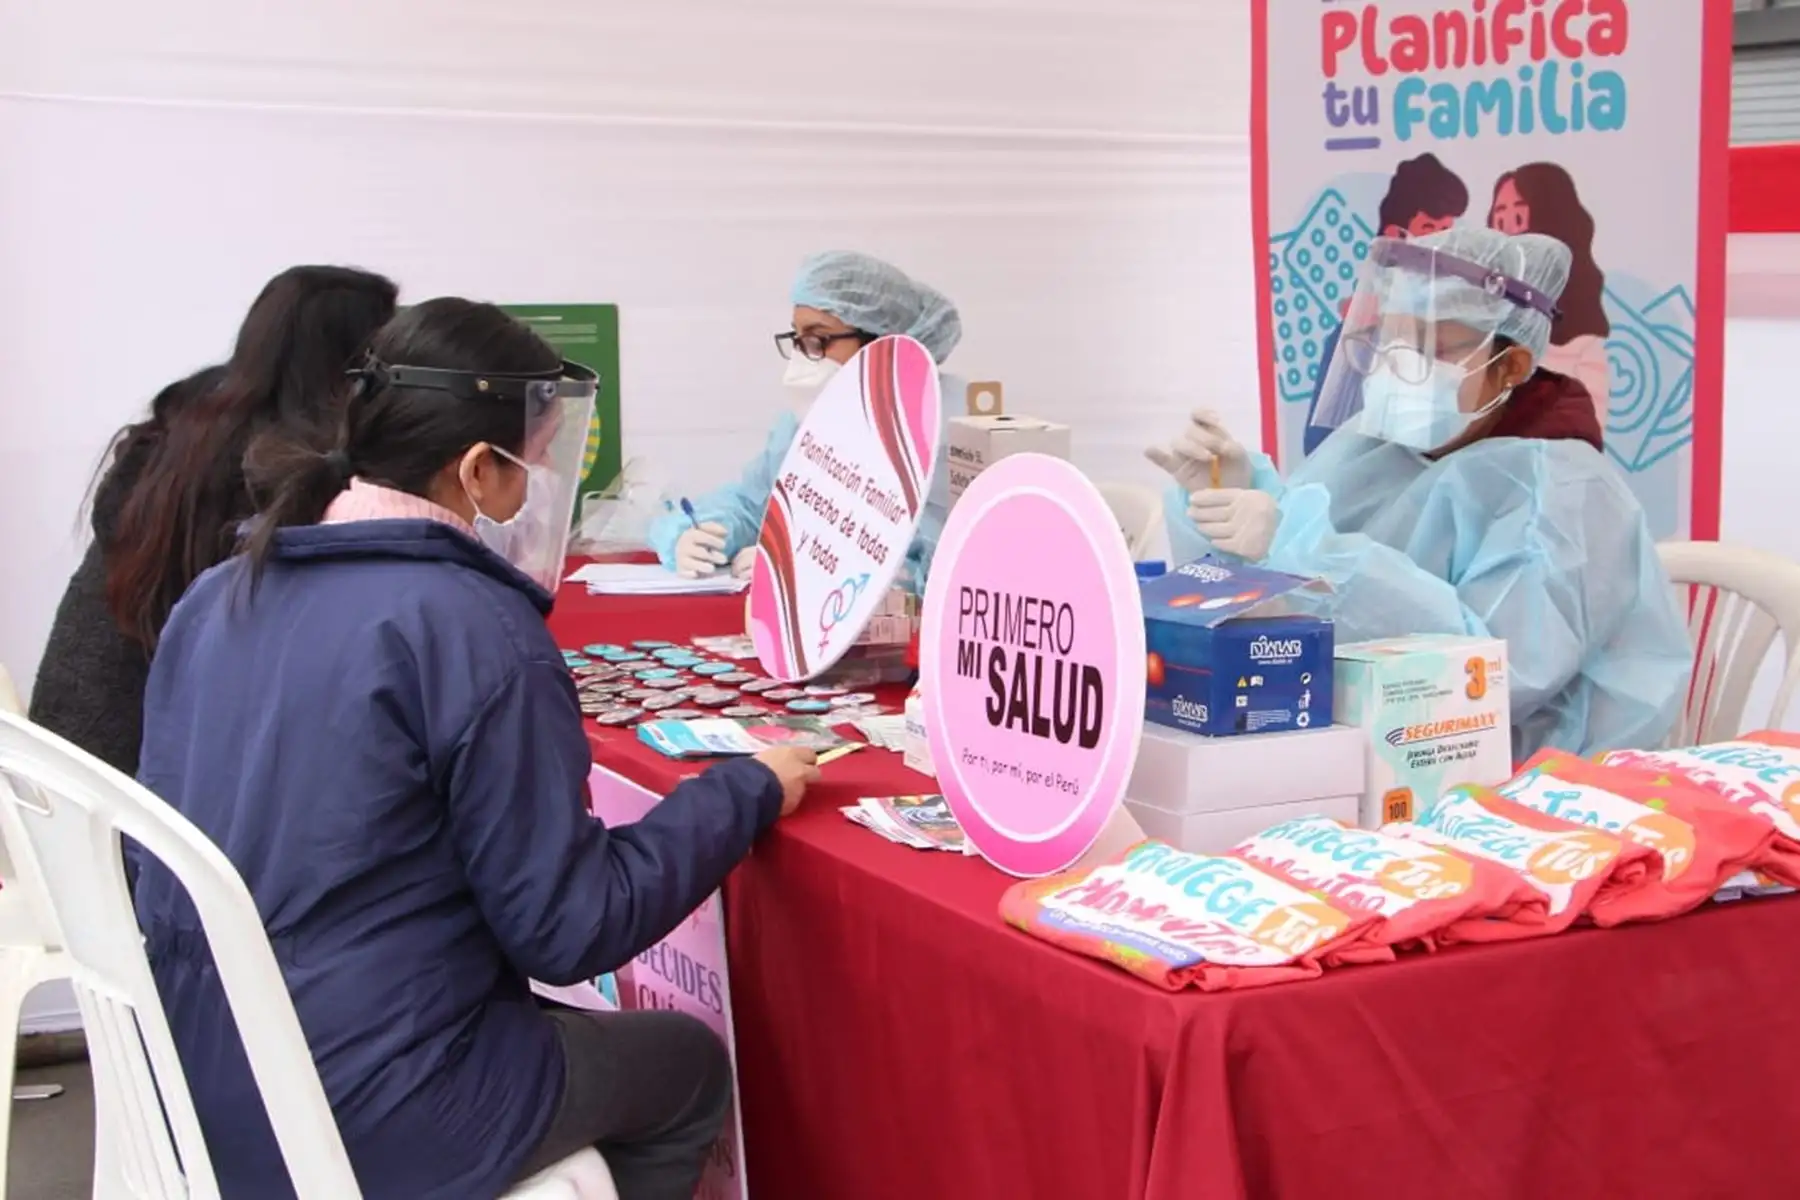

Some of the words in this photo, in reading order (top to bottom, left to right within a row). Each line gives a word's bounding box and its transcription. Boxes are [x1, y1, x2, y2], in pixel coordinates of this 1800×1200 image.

[1322, 82, 1380, 127] tu
[784, 472, 799, 492] es
[797, 478, 840, 526] derecho
[840, 509, 856, 538] de
[861, 477, 907, 526] Familiar
[796, 530, 809, 553] y
[957, 638, 982, 680] MI
[985, 645, 1104, 750] SALUD
[1464, 656, 1488, 701] 3
[1026, 769, 1043, 786] por
[1044, 772, 1055, 787] el
[1388, 801, 1408, 820] 100
